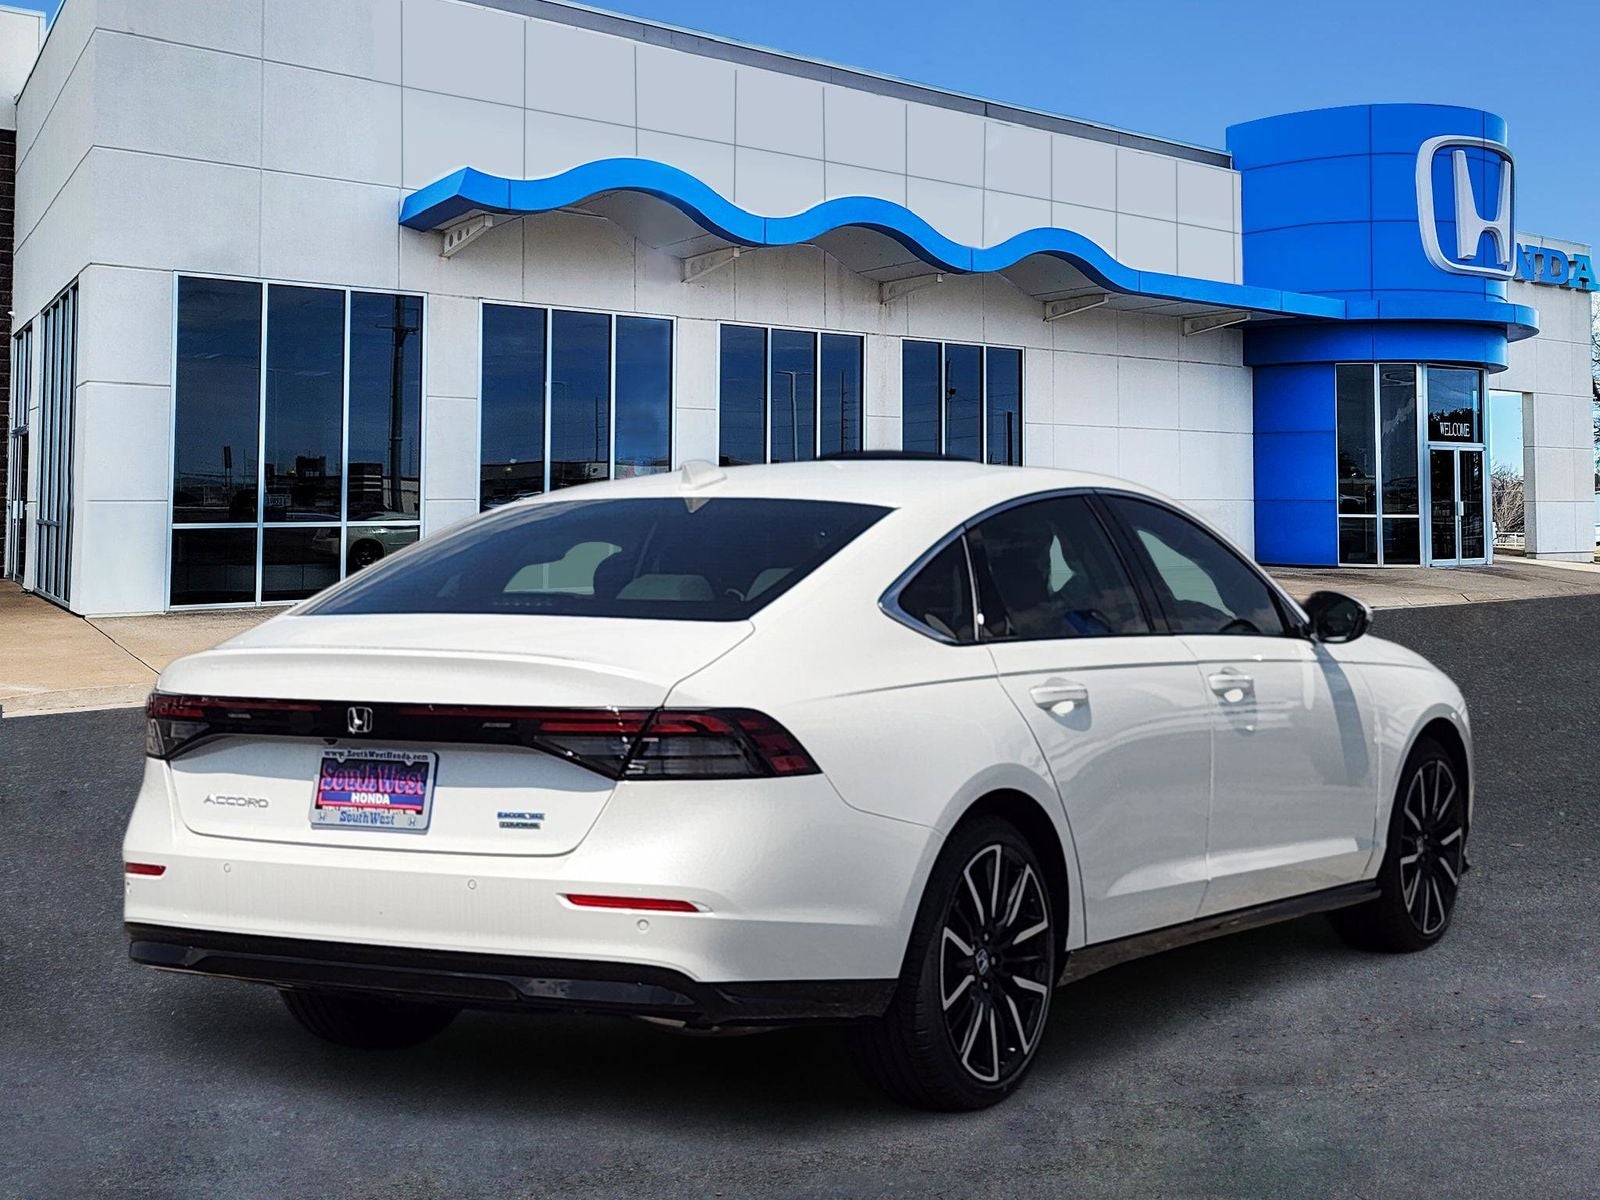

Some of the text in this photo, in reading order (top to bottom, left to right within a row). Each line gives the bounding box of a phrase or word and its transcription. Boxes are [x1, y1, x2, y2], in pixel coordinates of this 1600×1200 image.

[1440, 422, 1470, 437] WELCOME
[203, 795, 269, 808] ACCORD
[351, 792, 391, 805] HONDA
